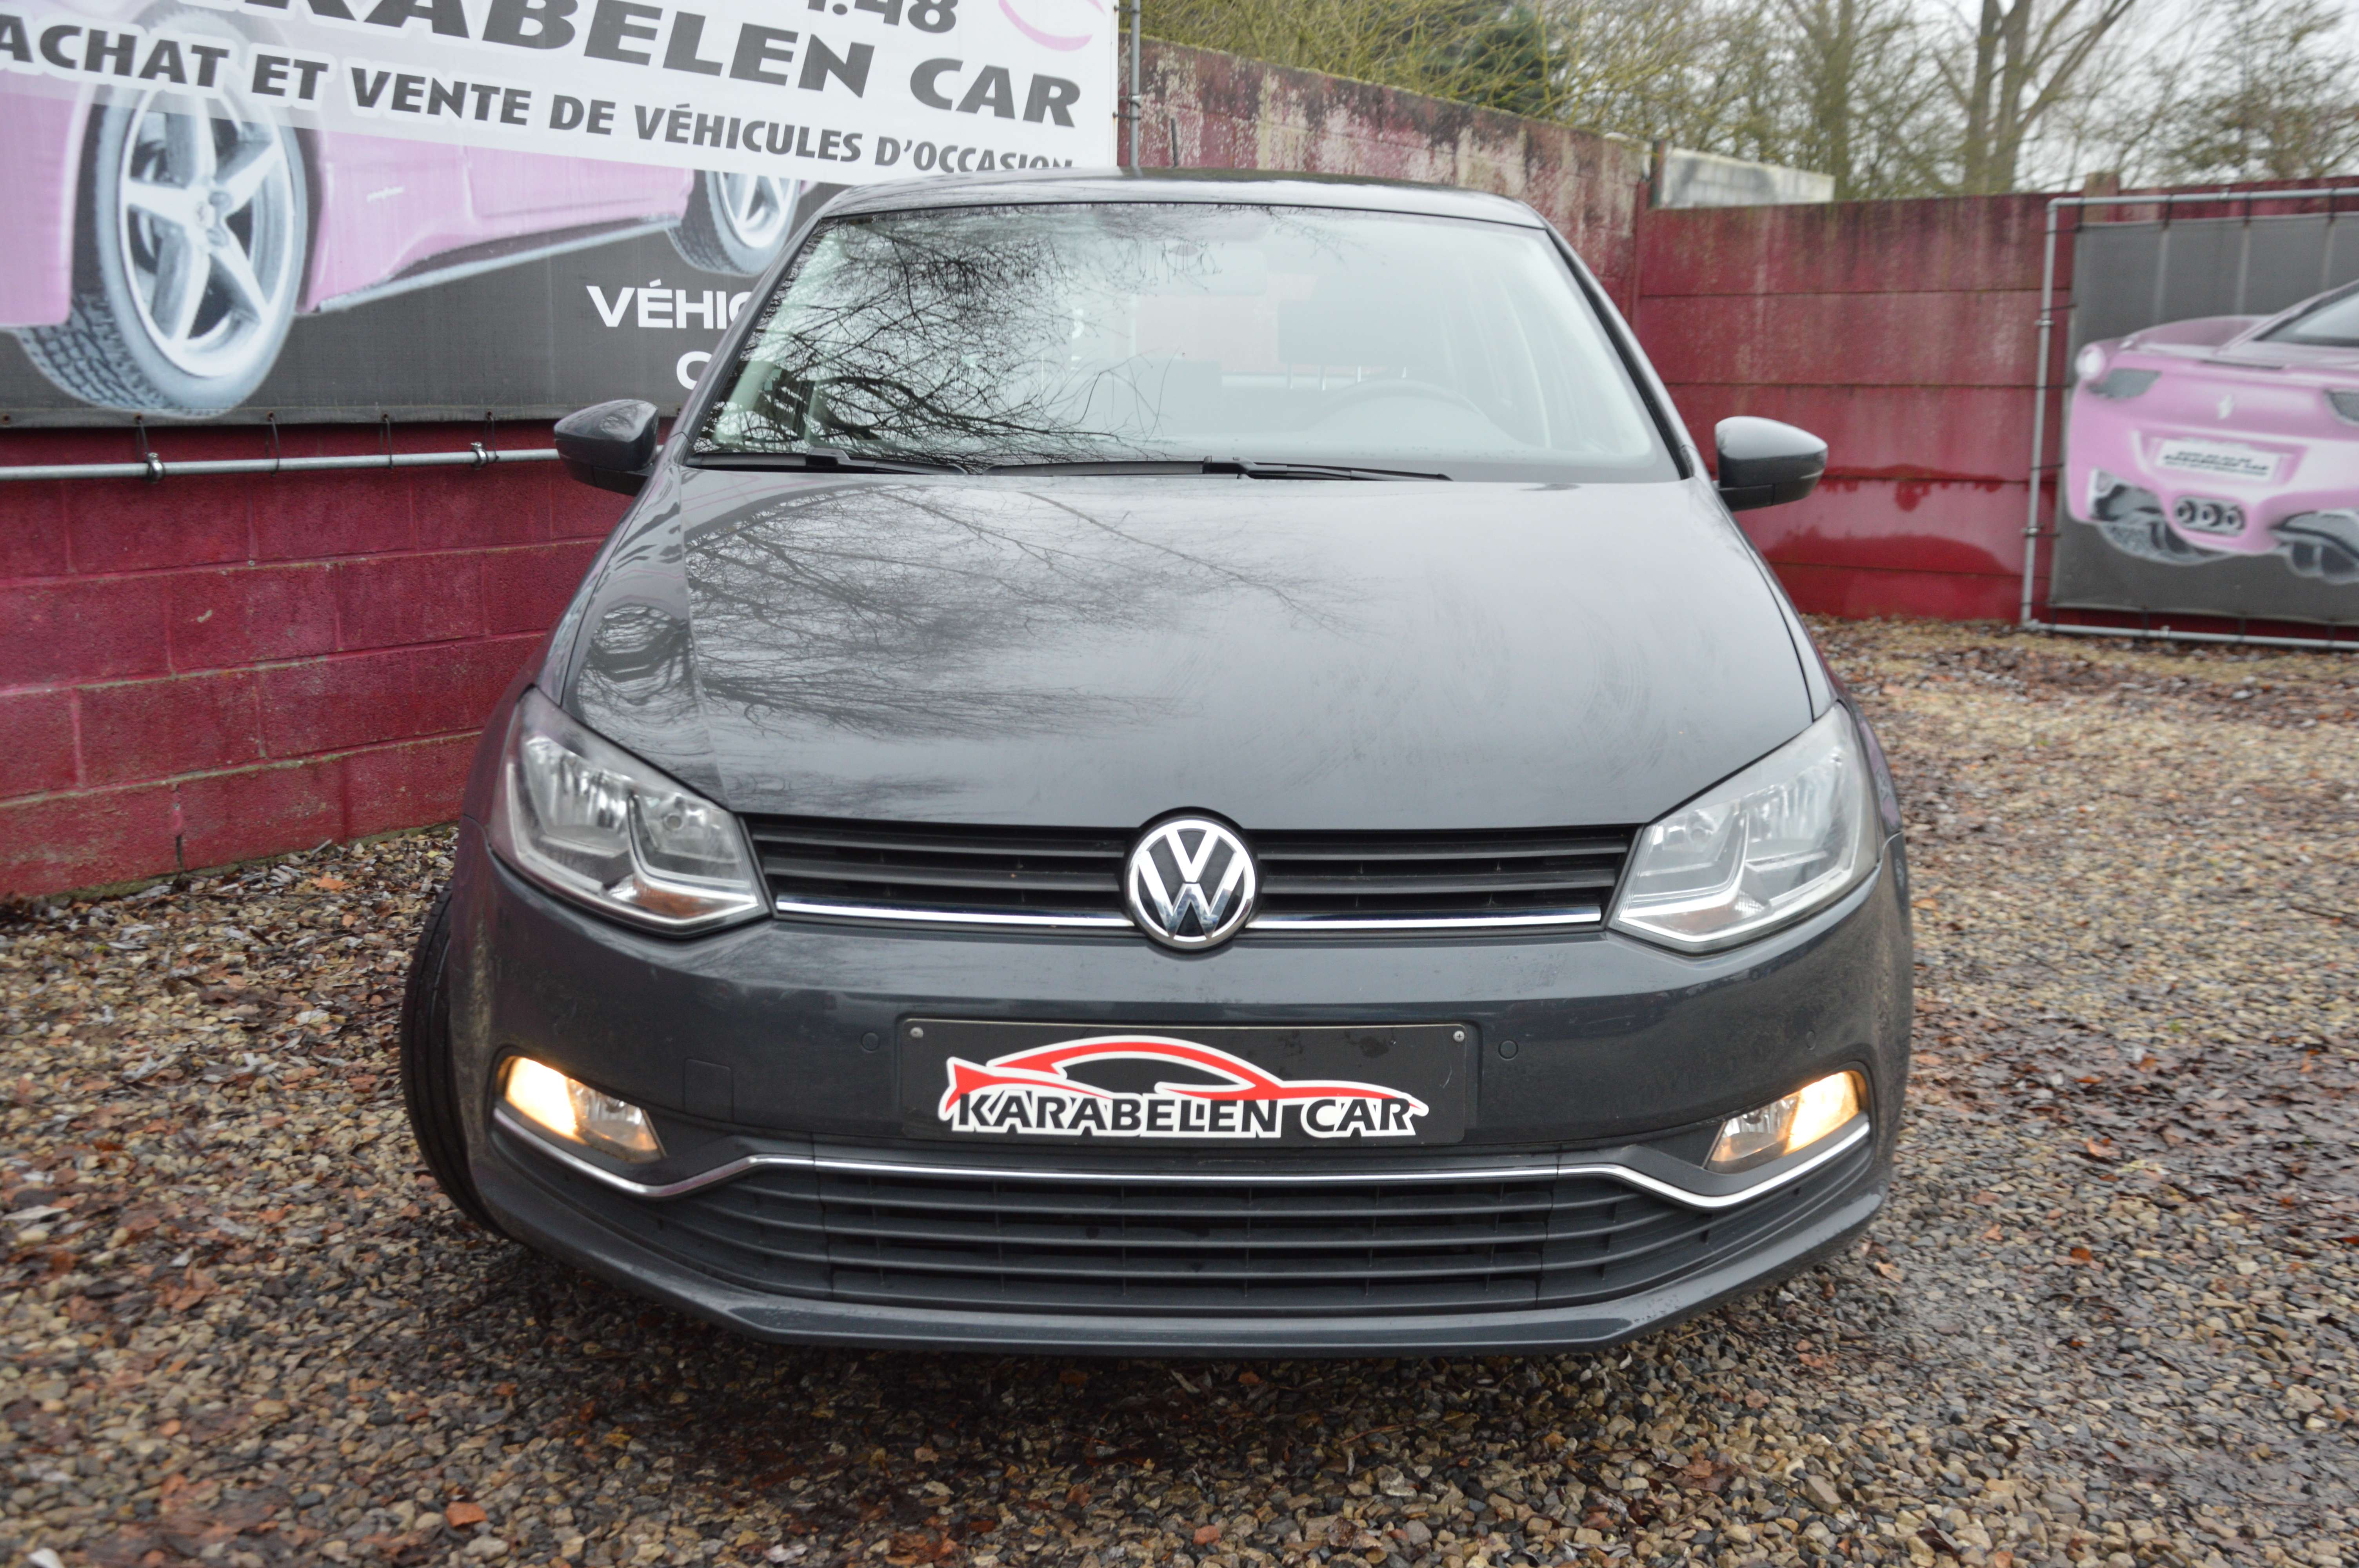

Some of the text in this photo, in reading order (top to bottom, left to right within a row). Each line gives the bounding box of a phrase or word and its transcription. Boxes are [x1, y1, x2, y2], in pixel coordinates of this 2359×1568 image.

[0, 13, 229, 87] ACHAT
[251, 53, 329, 100] ET
[351, 67, 532, 125] VENTE
[549, 94, 616, 135] DE
[634, 103, 863, 162] VÉHICULES
[910, 57, 1081, 128] CAR
[958, 1093, 1411, 1133] KARABELEN CAR
